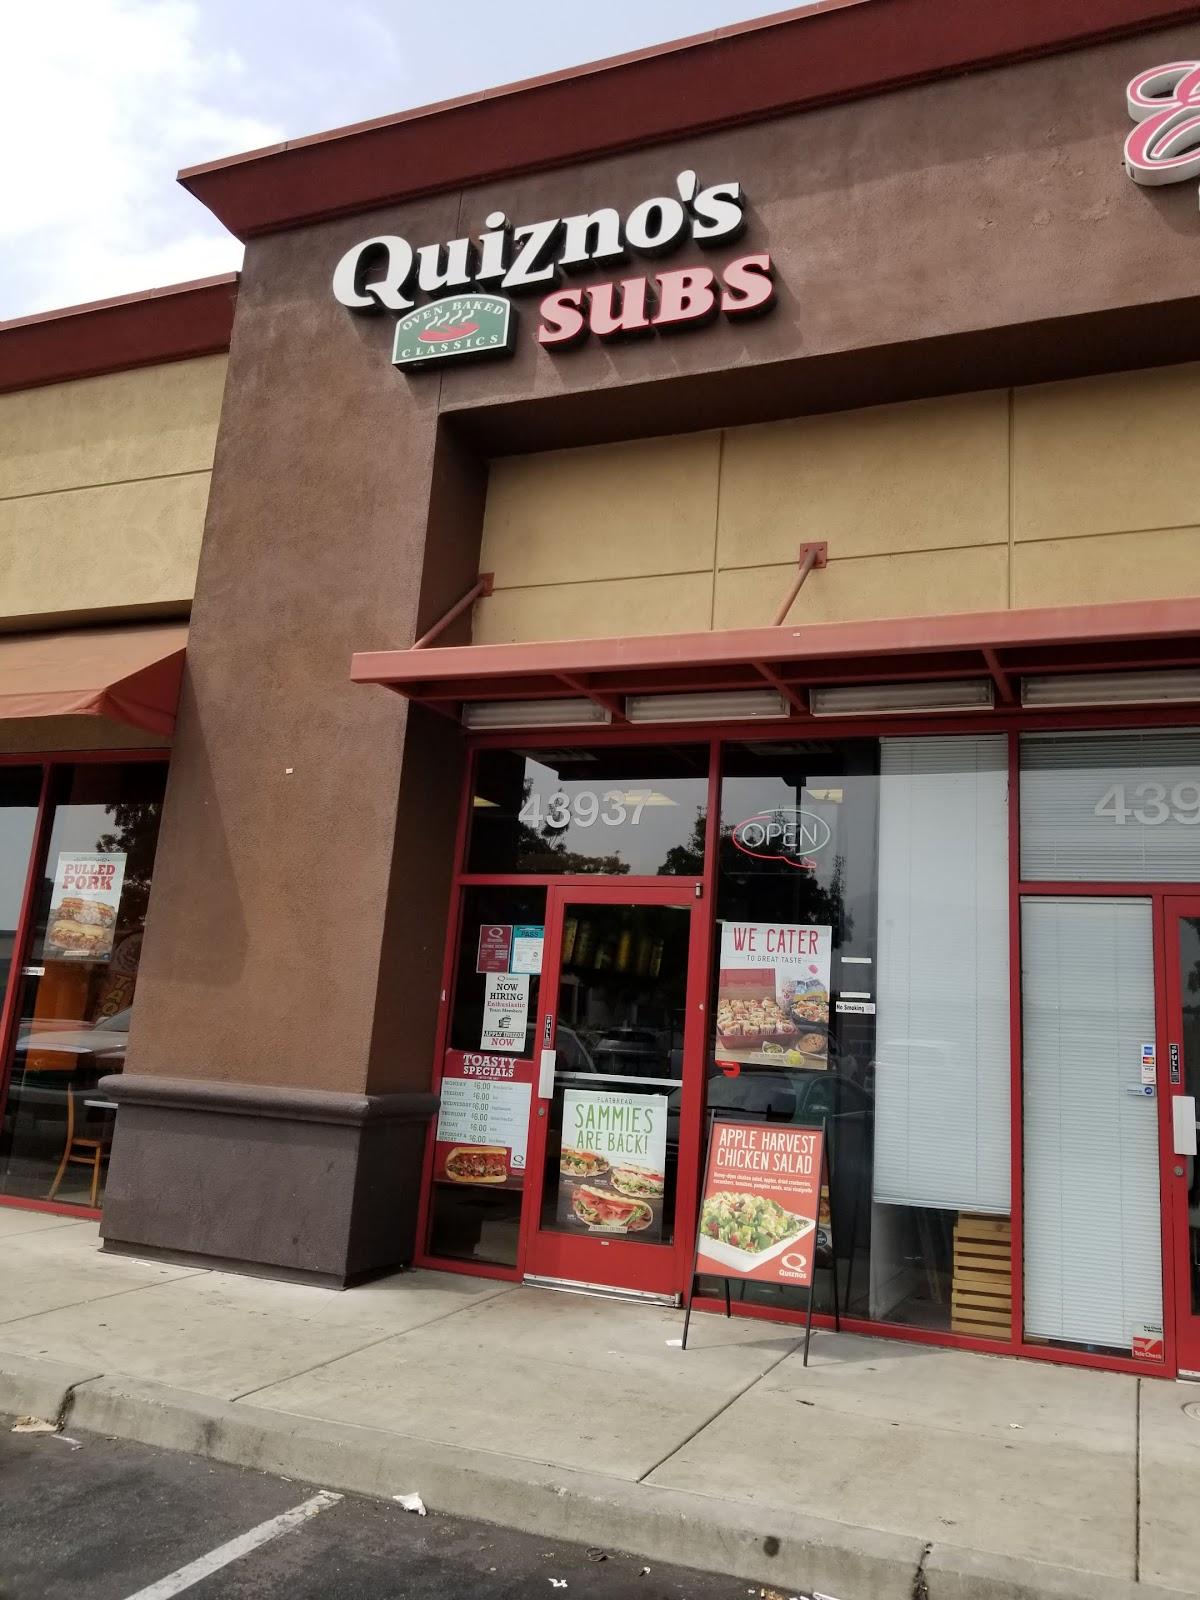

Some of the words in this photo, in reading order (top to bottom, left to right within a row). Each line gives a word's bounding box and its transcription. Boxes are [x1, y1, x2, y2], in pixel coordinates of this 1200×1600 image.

[332, 169, 743, 309] Quizno's
[538, 253, 774, 344] SUBS
[402, 306, 443, 330] OVEN
[452, 300, 504, 316] BAKED
[401, 334, 499, 358] CLASSICS
[518, 788, 652, 828] 43937
[742, 822, 818, 848] OPEN
[64, 863, 116, 875] PULLED
[62, 875, 113, 890] PORK
[733, 927, 758, 952] WE
[766, 928, 819, 955] CATER
[746, 954, 756, 962] TO
[757, 955, 779, 963] GREAT
[781, 956, 802, 964] TASTE
[490, 992, 524, 1001] HIRING
[496, 983, 519, 991] NOW
[491, 1037, 516, 1047] NOW
[463, 1053, 518, 1069] TOASTY
[463, 1066, 514, 1078] SPECIALS
[574, 1103, 654, 1134] SAMMIES
[576, 1130, 603, 1151] ARE
[607, 1132, 649, 1154] BACK!
[719, 1128, 757, 1150] APPLE
[761, 1131, 816, 1155] HARVEST
[716, 1148, 769, 1171] CHICKEN
[772, 1152, 812, 1175] SALAD
